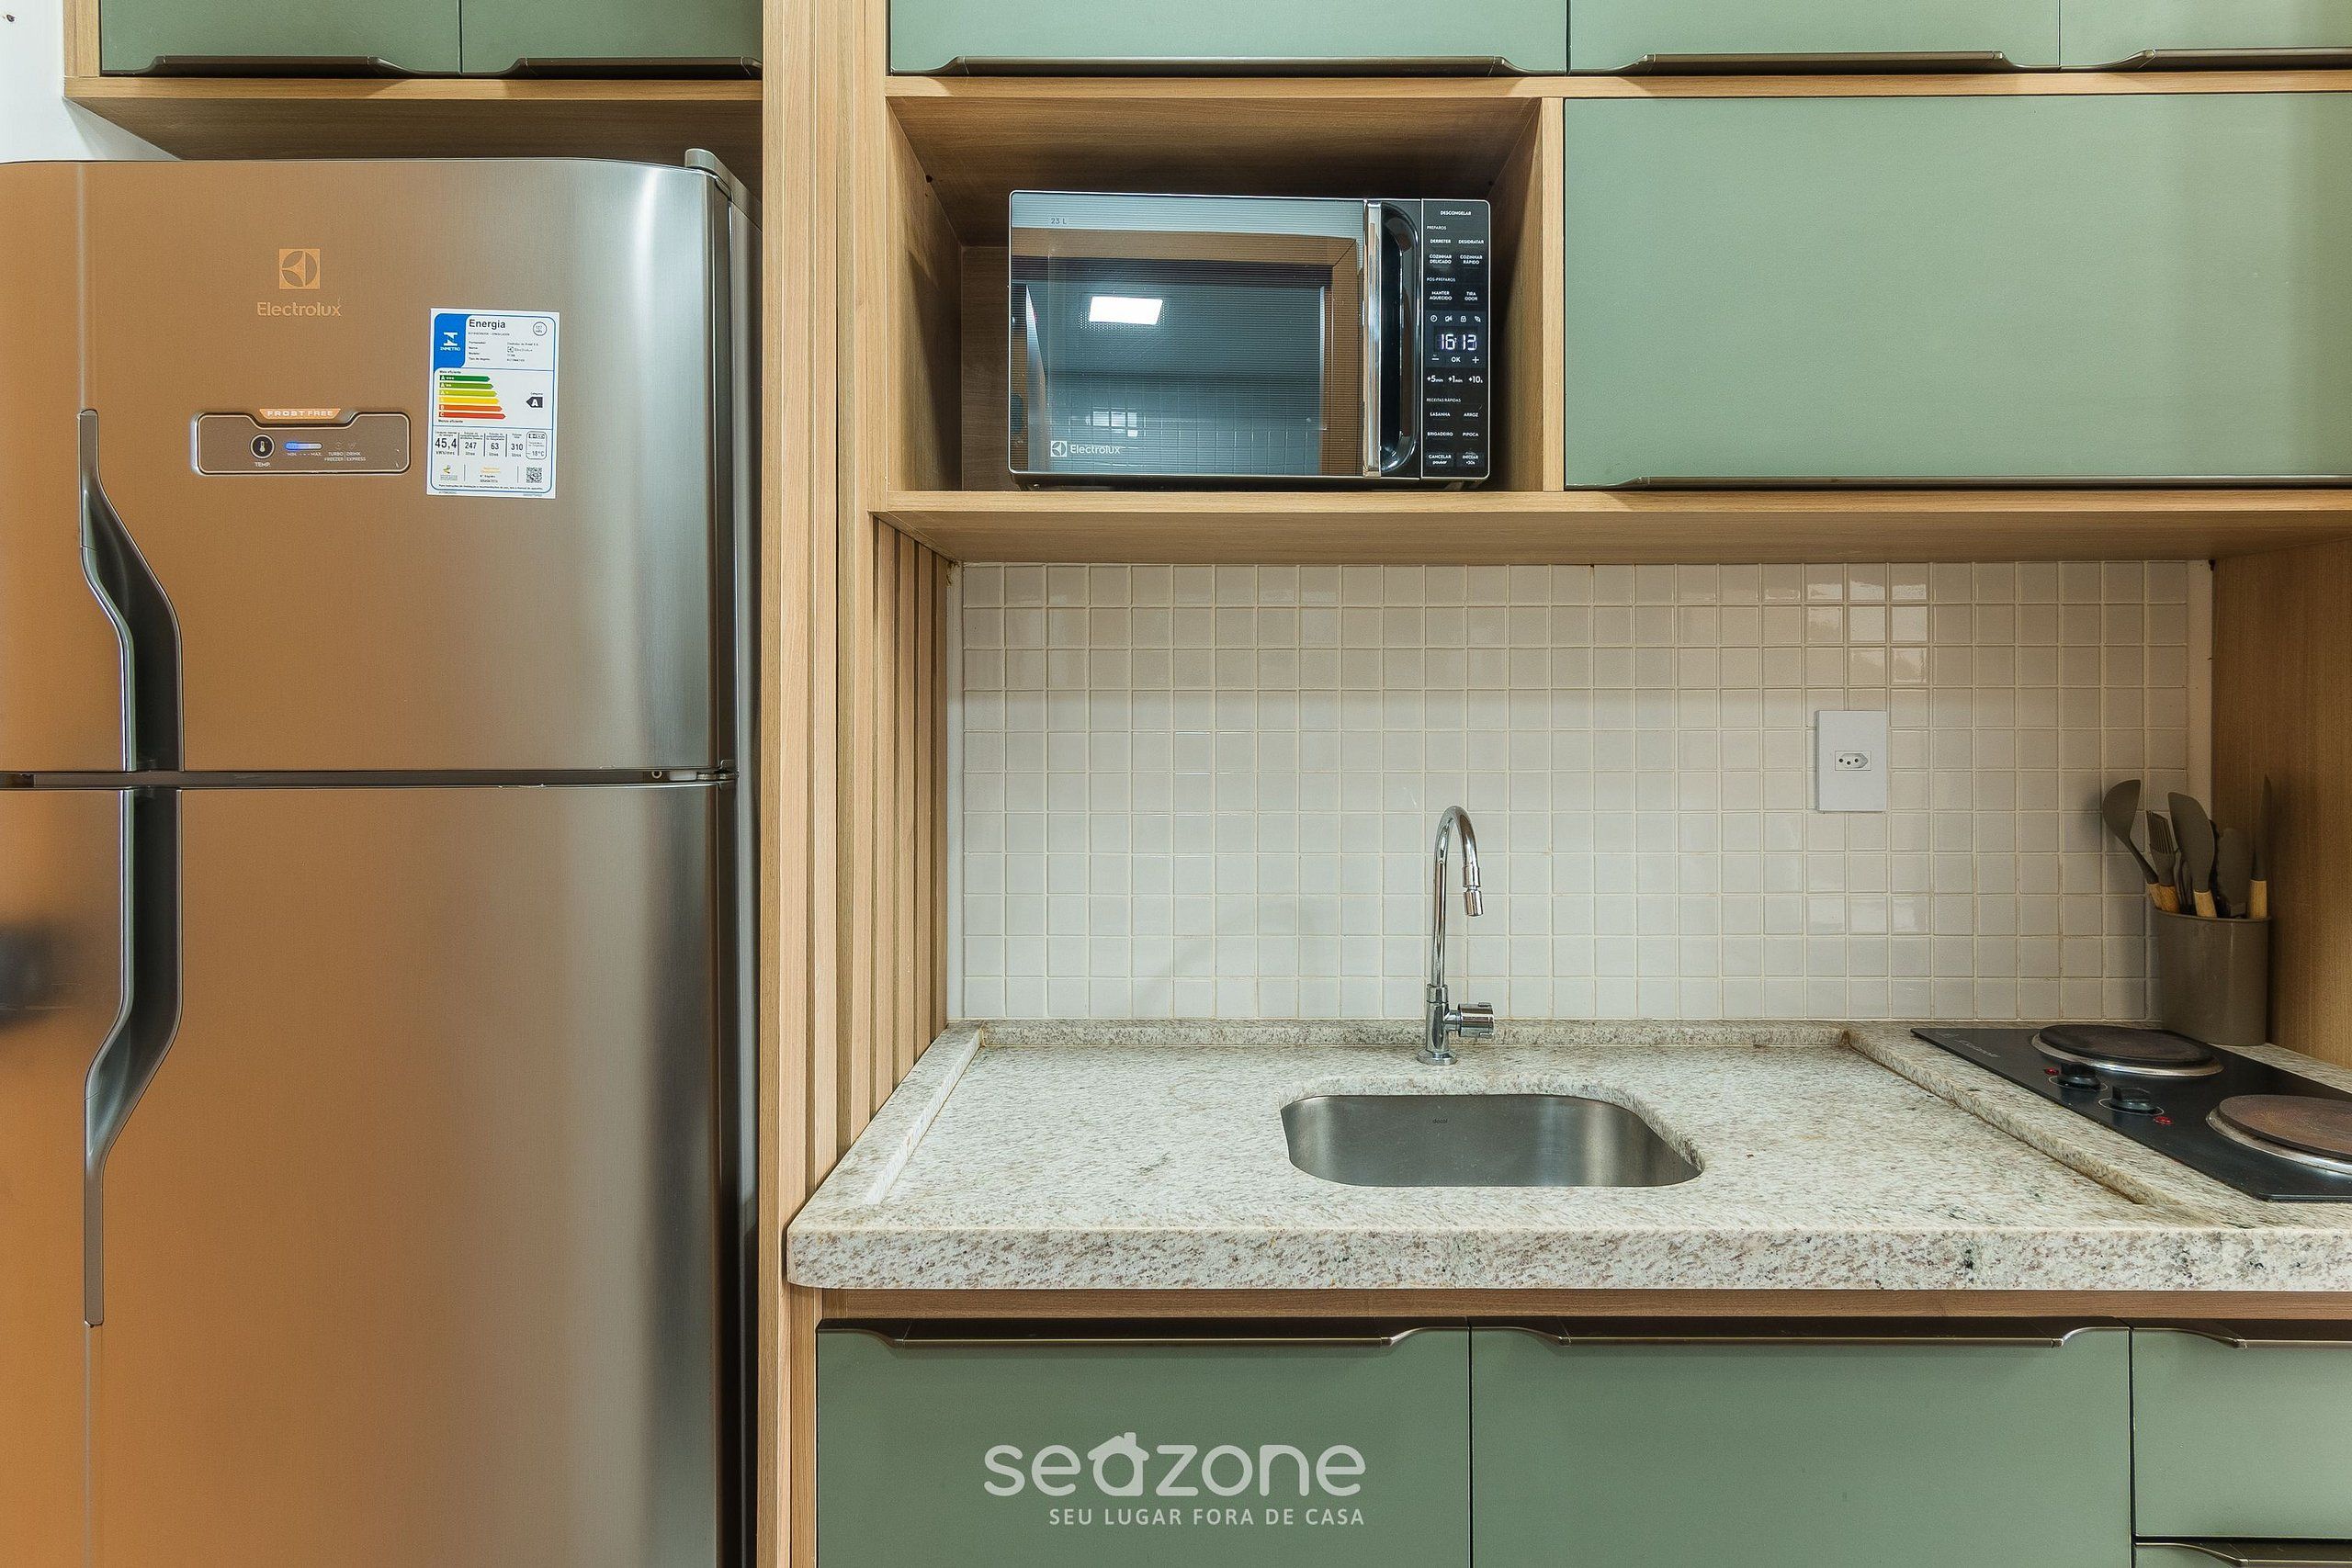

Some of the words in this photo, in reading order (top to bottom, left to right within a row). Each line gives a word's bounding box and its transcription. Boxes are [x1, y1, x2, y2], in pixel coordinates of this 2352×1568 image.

[257, 302, 342, 317] Electrolux
[469, 319, 506, 330] Energia
[531, 399, 539, 407] A
[435, 437, 458, 450] 45,4
[511, 443, 524, 451] 310
[1070, 445, 1121, 454] Electrolux
